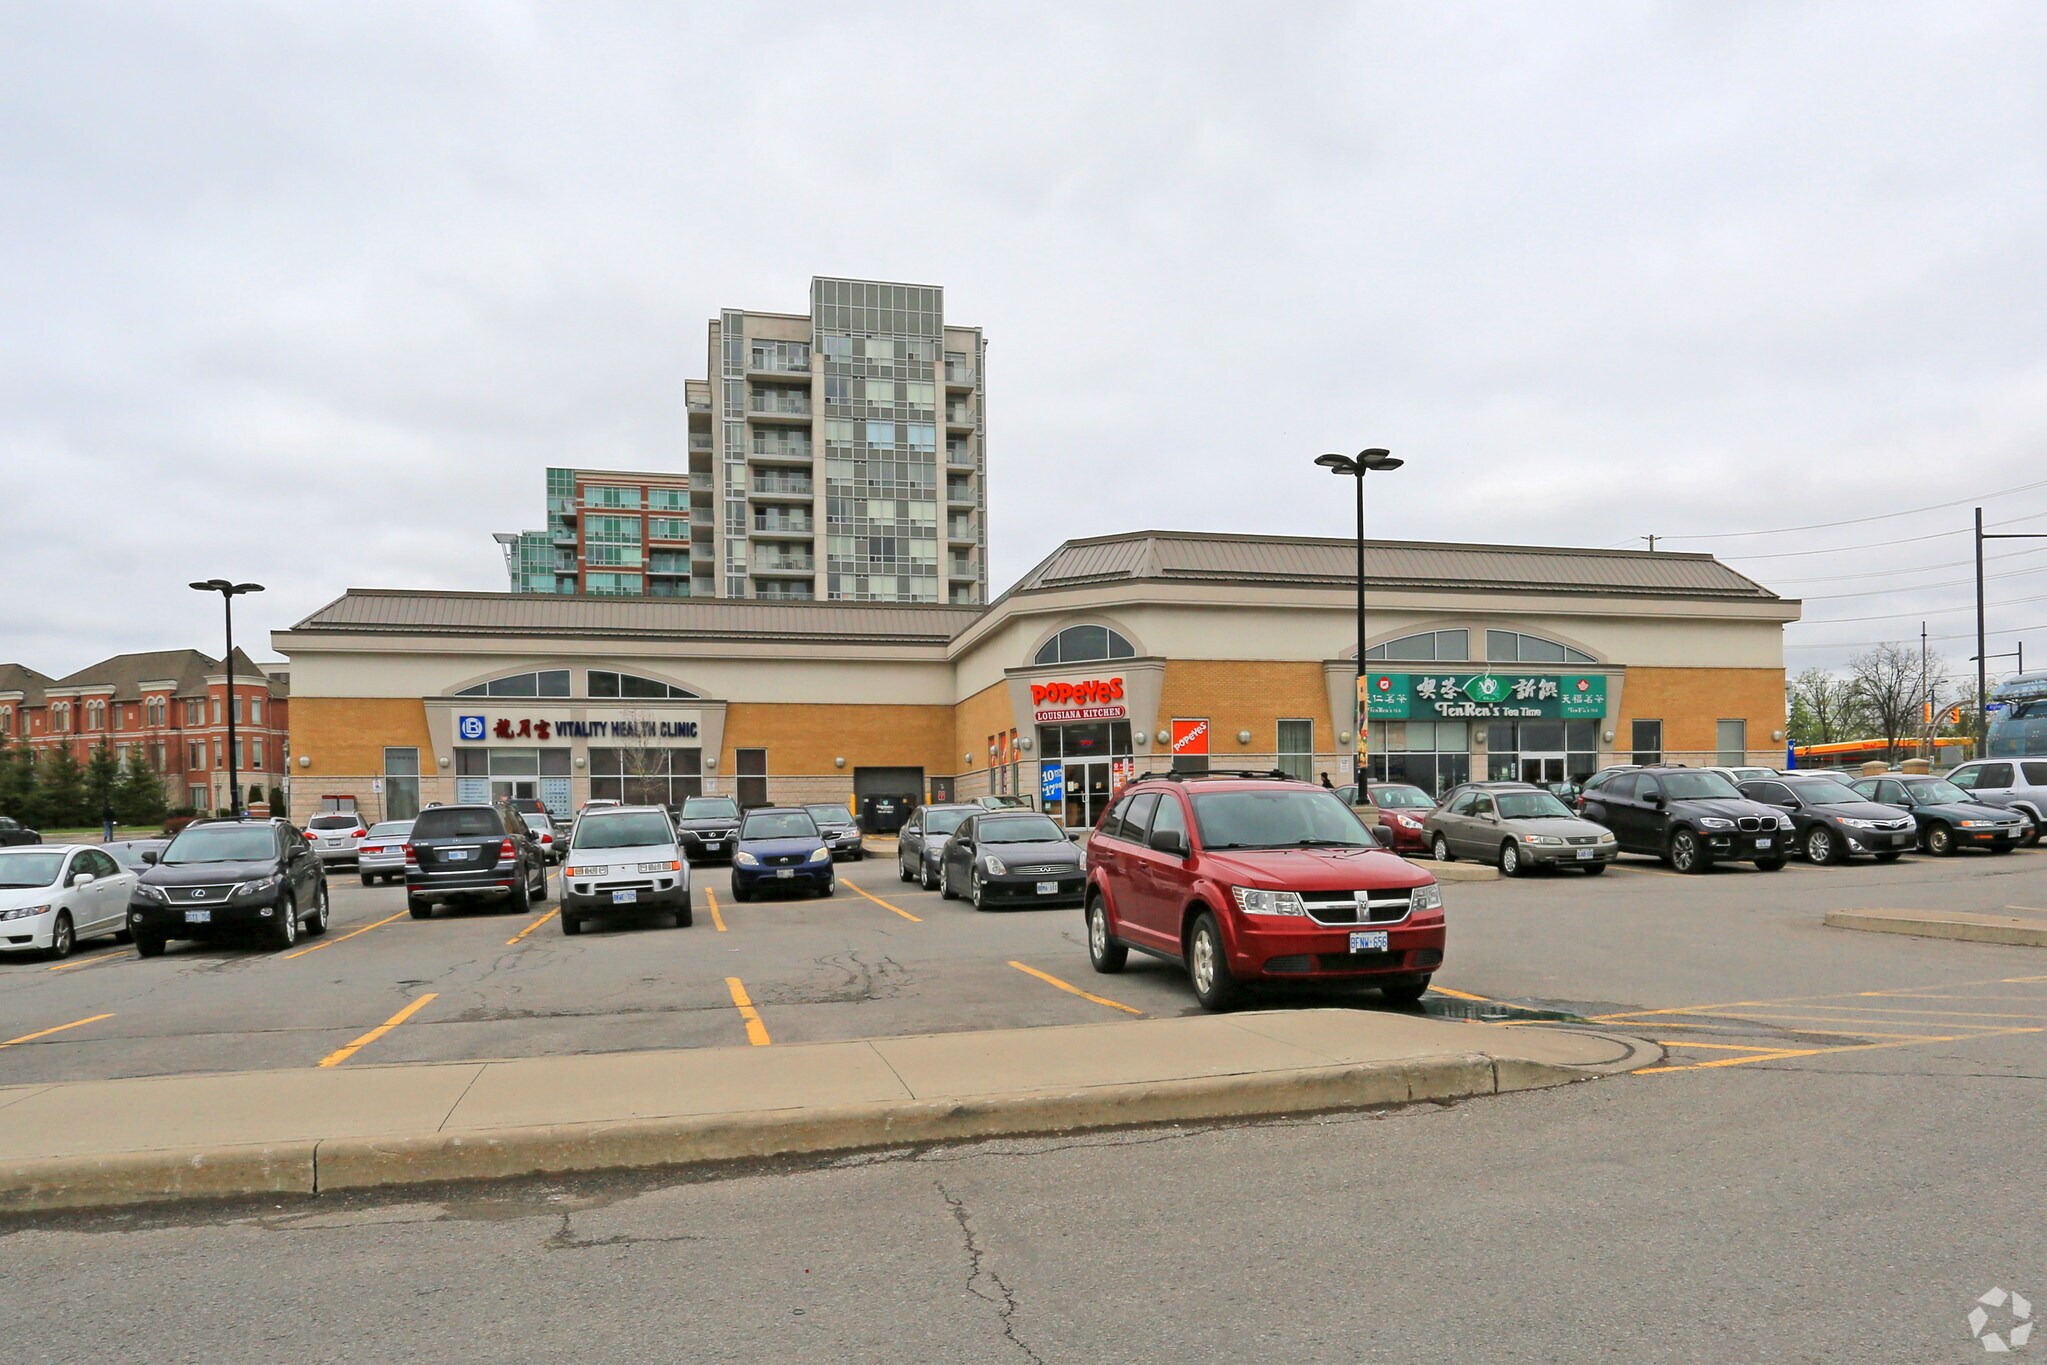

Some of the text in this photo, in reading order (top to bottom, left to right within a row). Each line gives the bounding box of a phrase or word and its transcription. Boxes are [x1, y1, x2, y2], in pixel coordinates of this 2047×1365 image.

[1037, 706, 1121, 721] LOUISIANA KITCHEN
[1503, 707, 1519, 717] Tea
[1521, 707, 1542, 717] Time
[554, 721, 698, 738] VITALITY HEALTH CLINIC
[1042, 770, 1055, 783] 10
